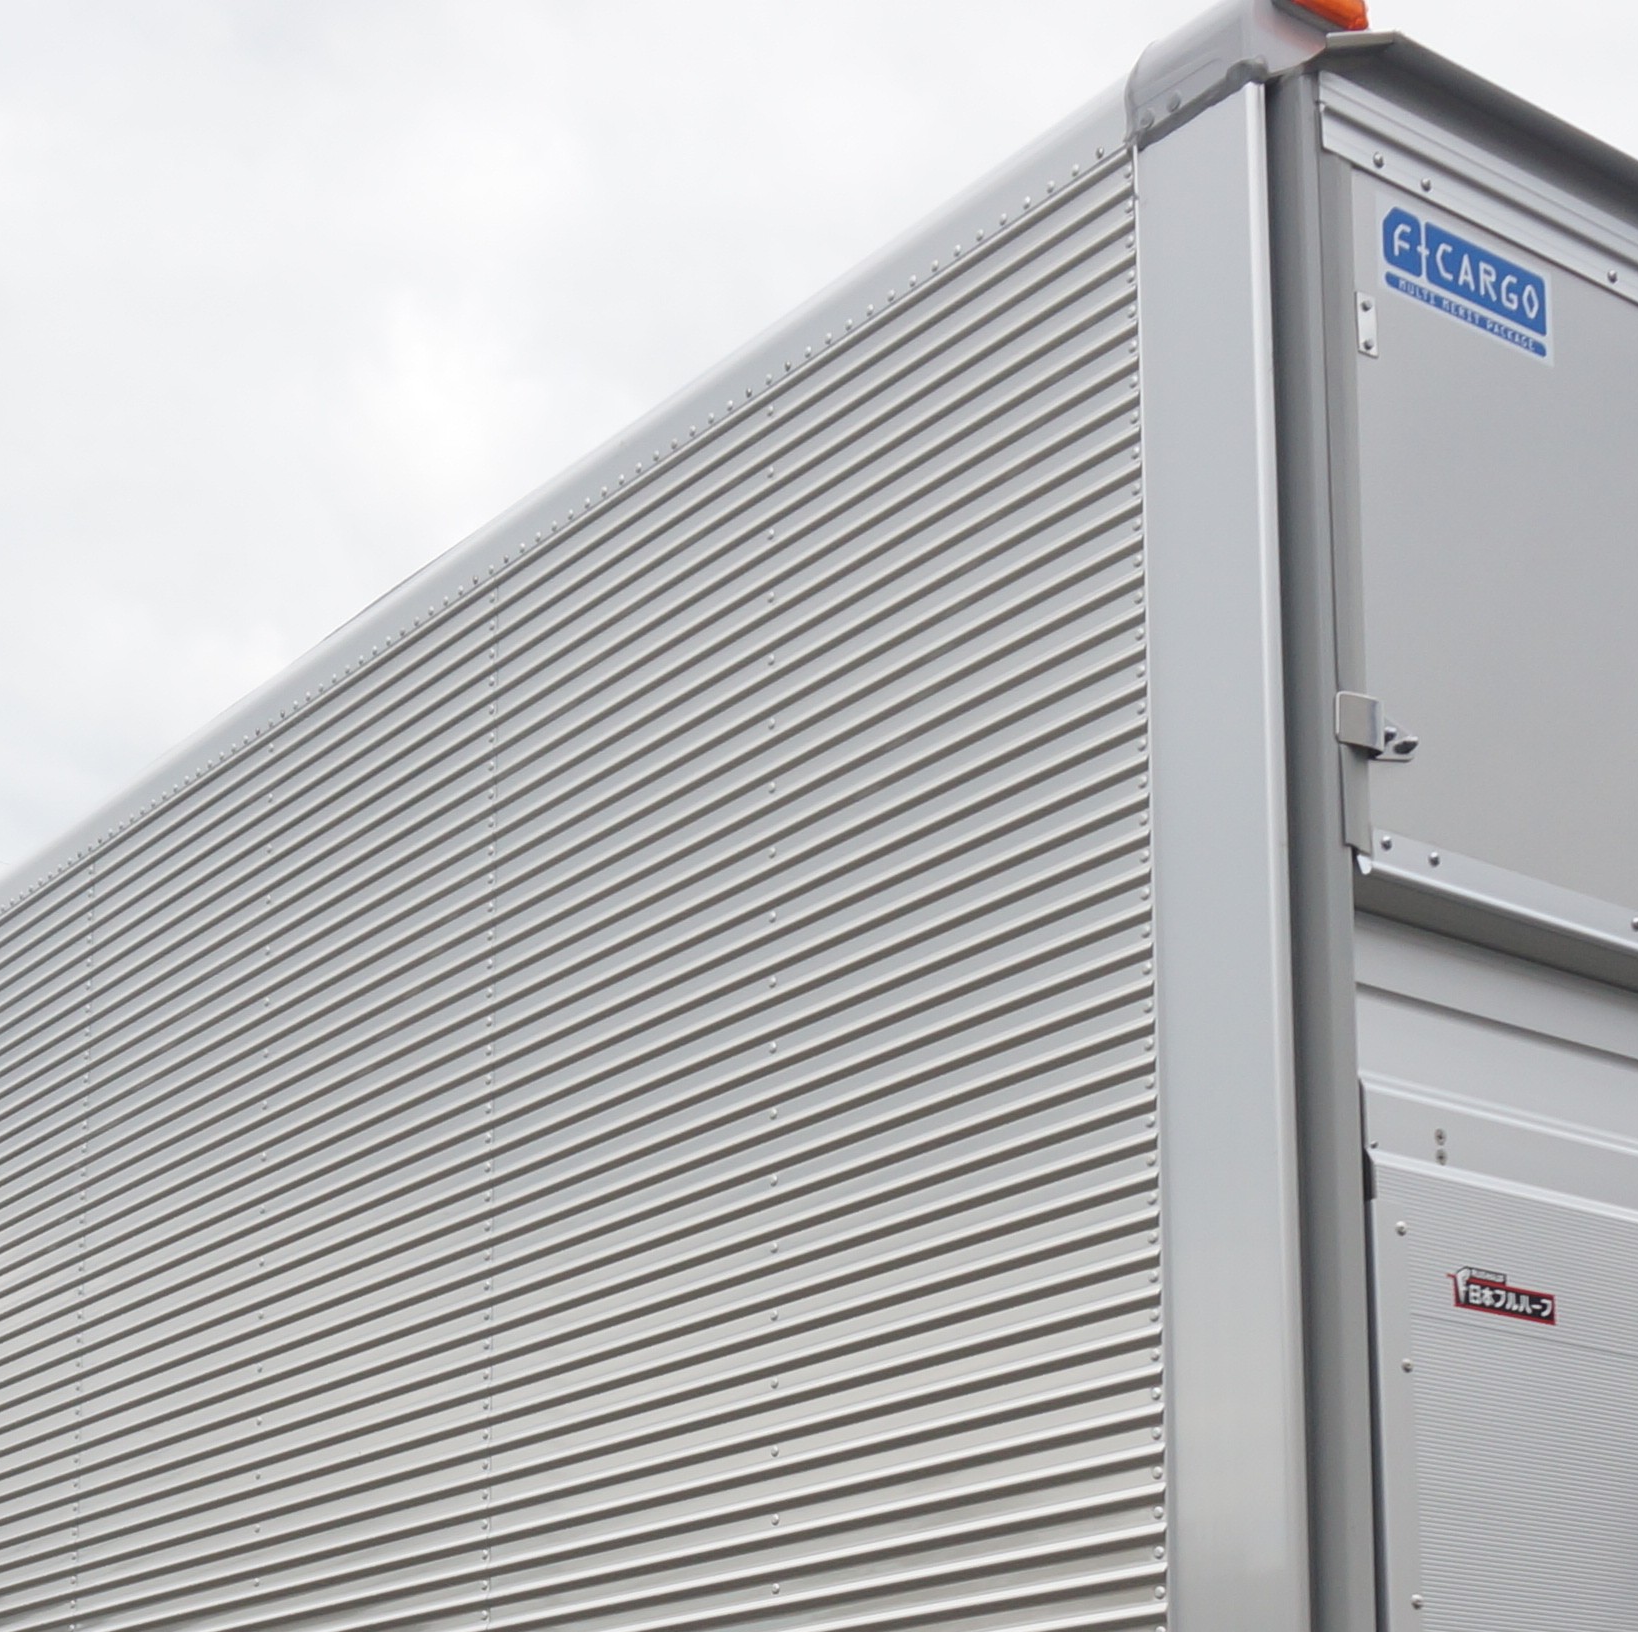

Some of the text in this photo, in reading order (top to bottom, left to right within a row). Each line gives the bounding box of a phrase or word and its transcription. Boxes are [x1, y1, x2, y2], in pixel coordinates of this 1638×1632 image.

[1397, 279, 1437, 306] MULTI
[1485, 317, 1536, 353] PACKAGE
[1468, 1284, 1553, 1317] 日本フルハーフ
